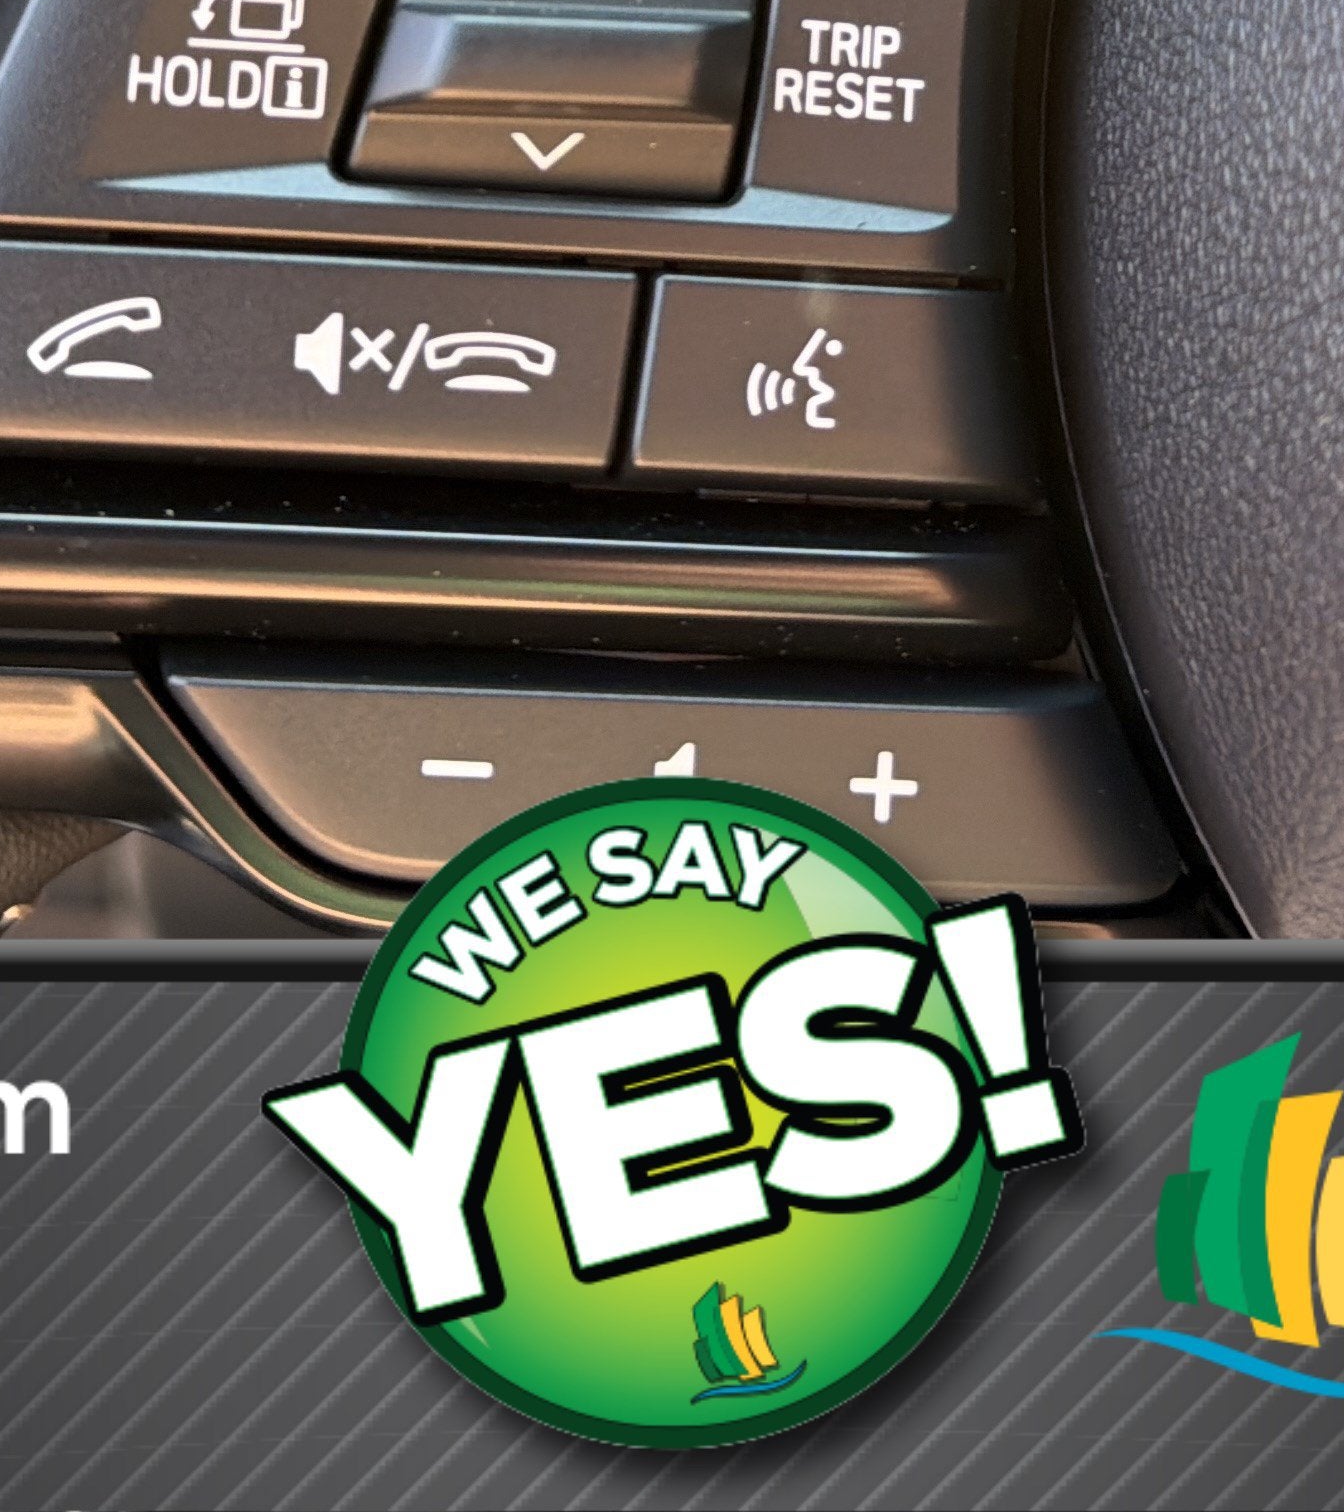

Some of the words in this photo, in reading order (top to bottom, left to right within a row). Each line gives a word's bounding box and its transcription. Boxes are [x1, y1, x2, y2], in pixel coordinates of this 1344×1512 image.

[800, 18, 902, 70] TRIP
[126, 52, 263, 110] HOLD
[773, 67, 926, 123] RESET
